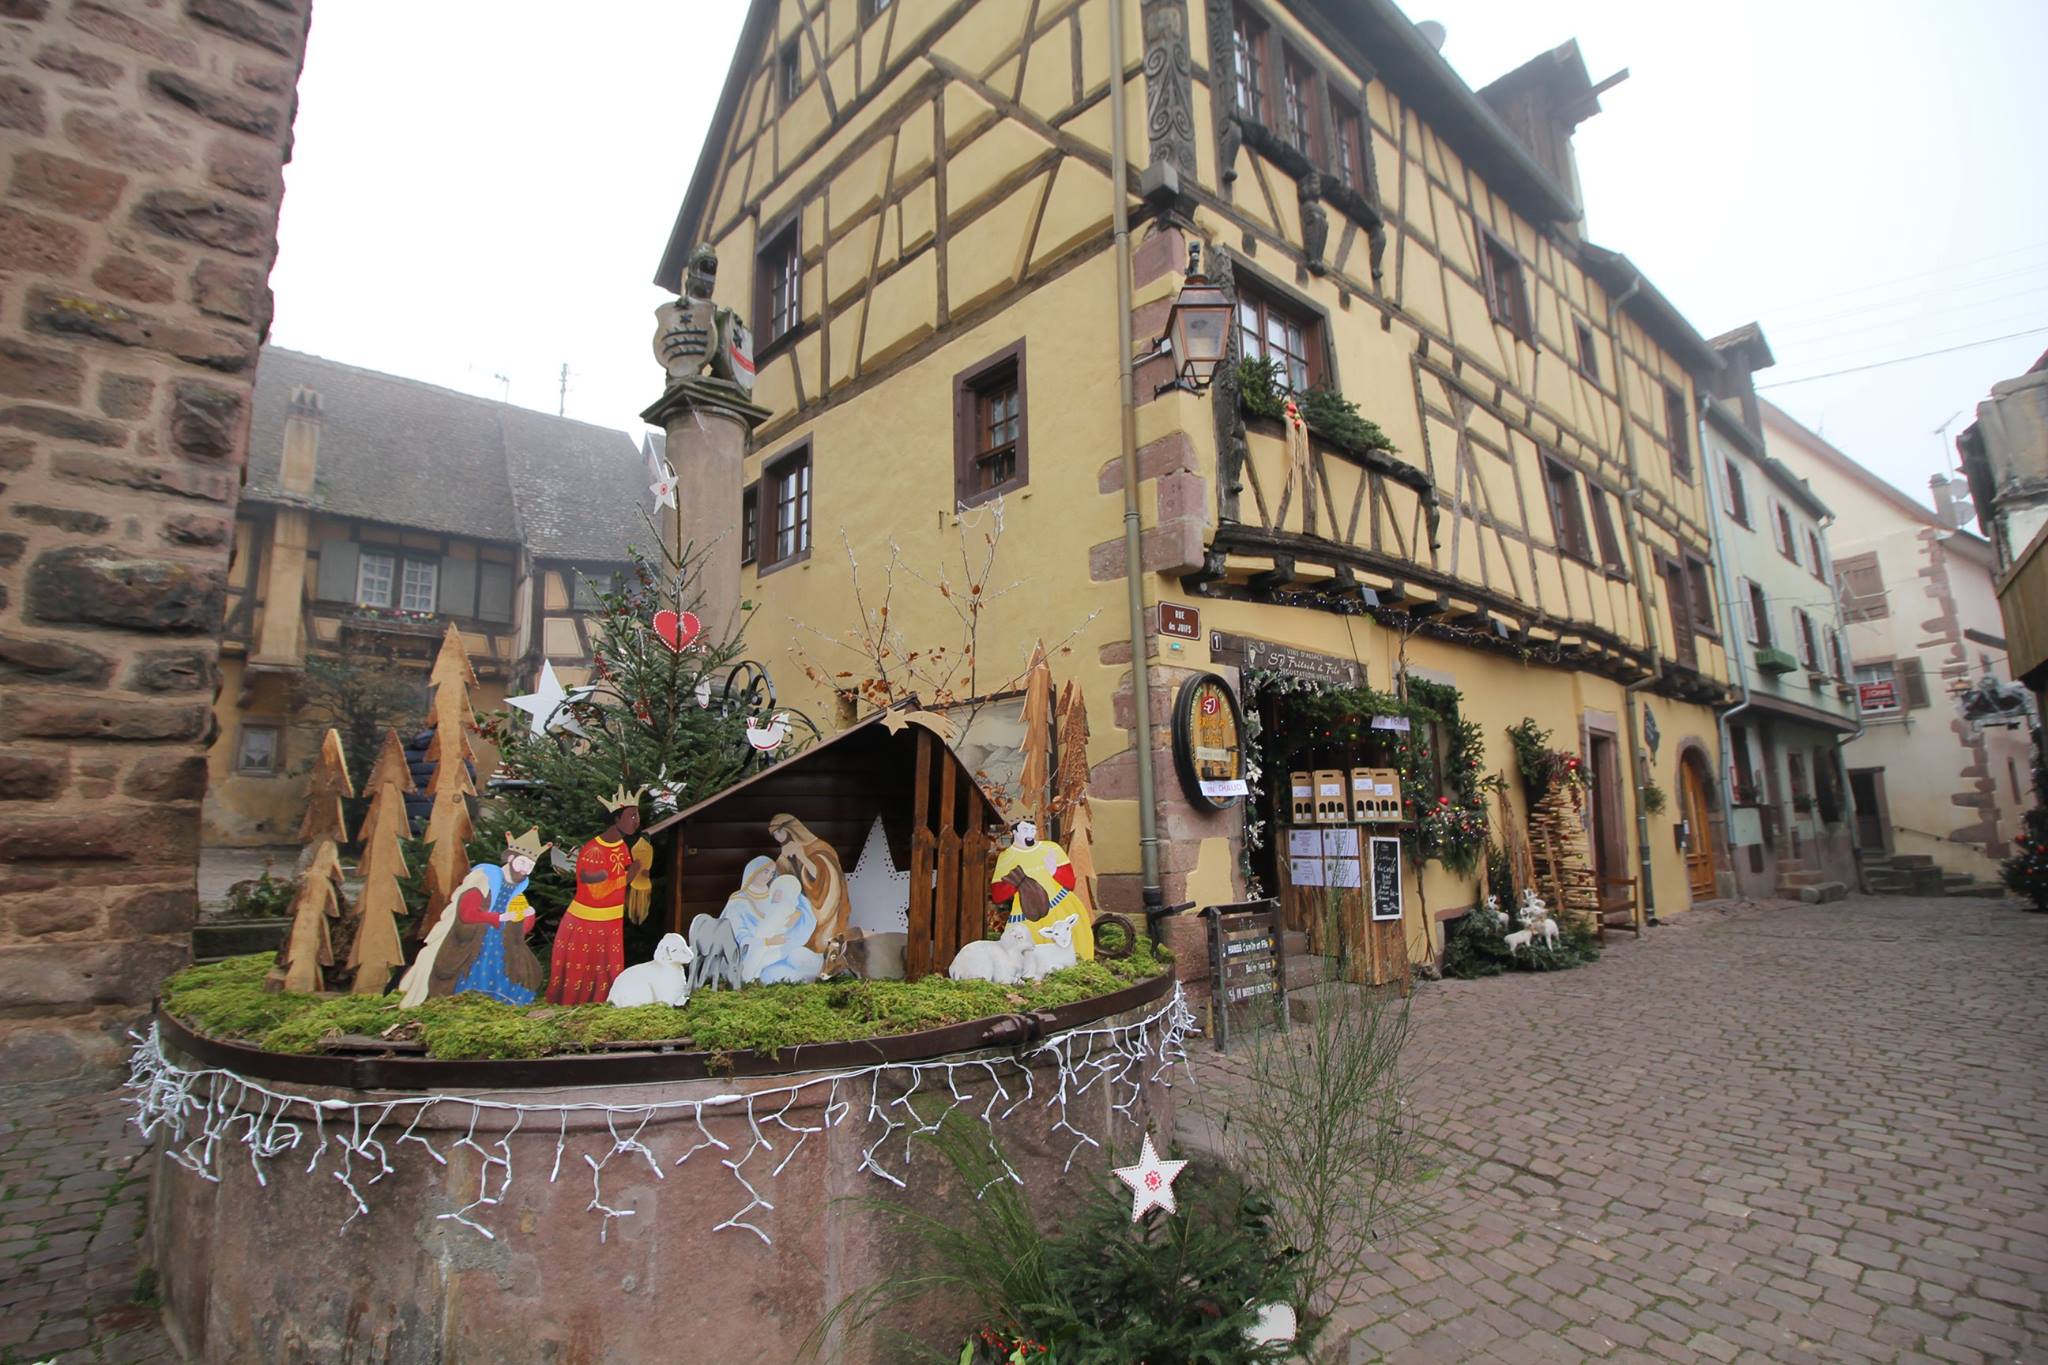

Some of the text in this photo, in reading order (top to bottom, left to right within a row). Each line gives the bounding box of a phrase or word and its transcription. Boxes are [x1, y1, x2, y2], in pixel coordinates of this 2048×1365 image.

[1174, 610, 1185, 620] RUE
[1177, 623, 1192, 634] JUIFS
[1214, 635, 1219, 649] 1
